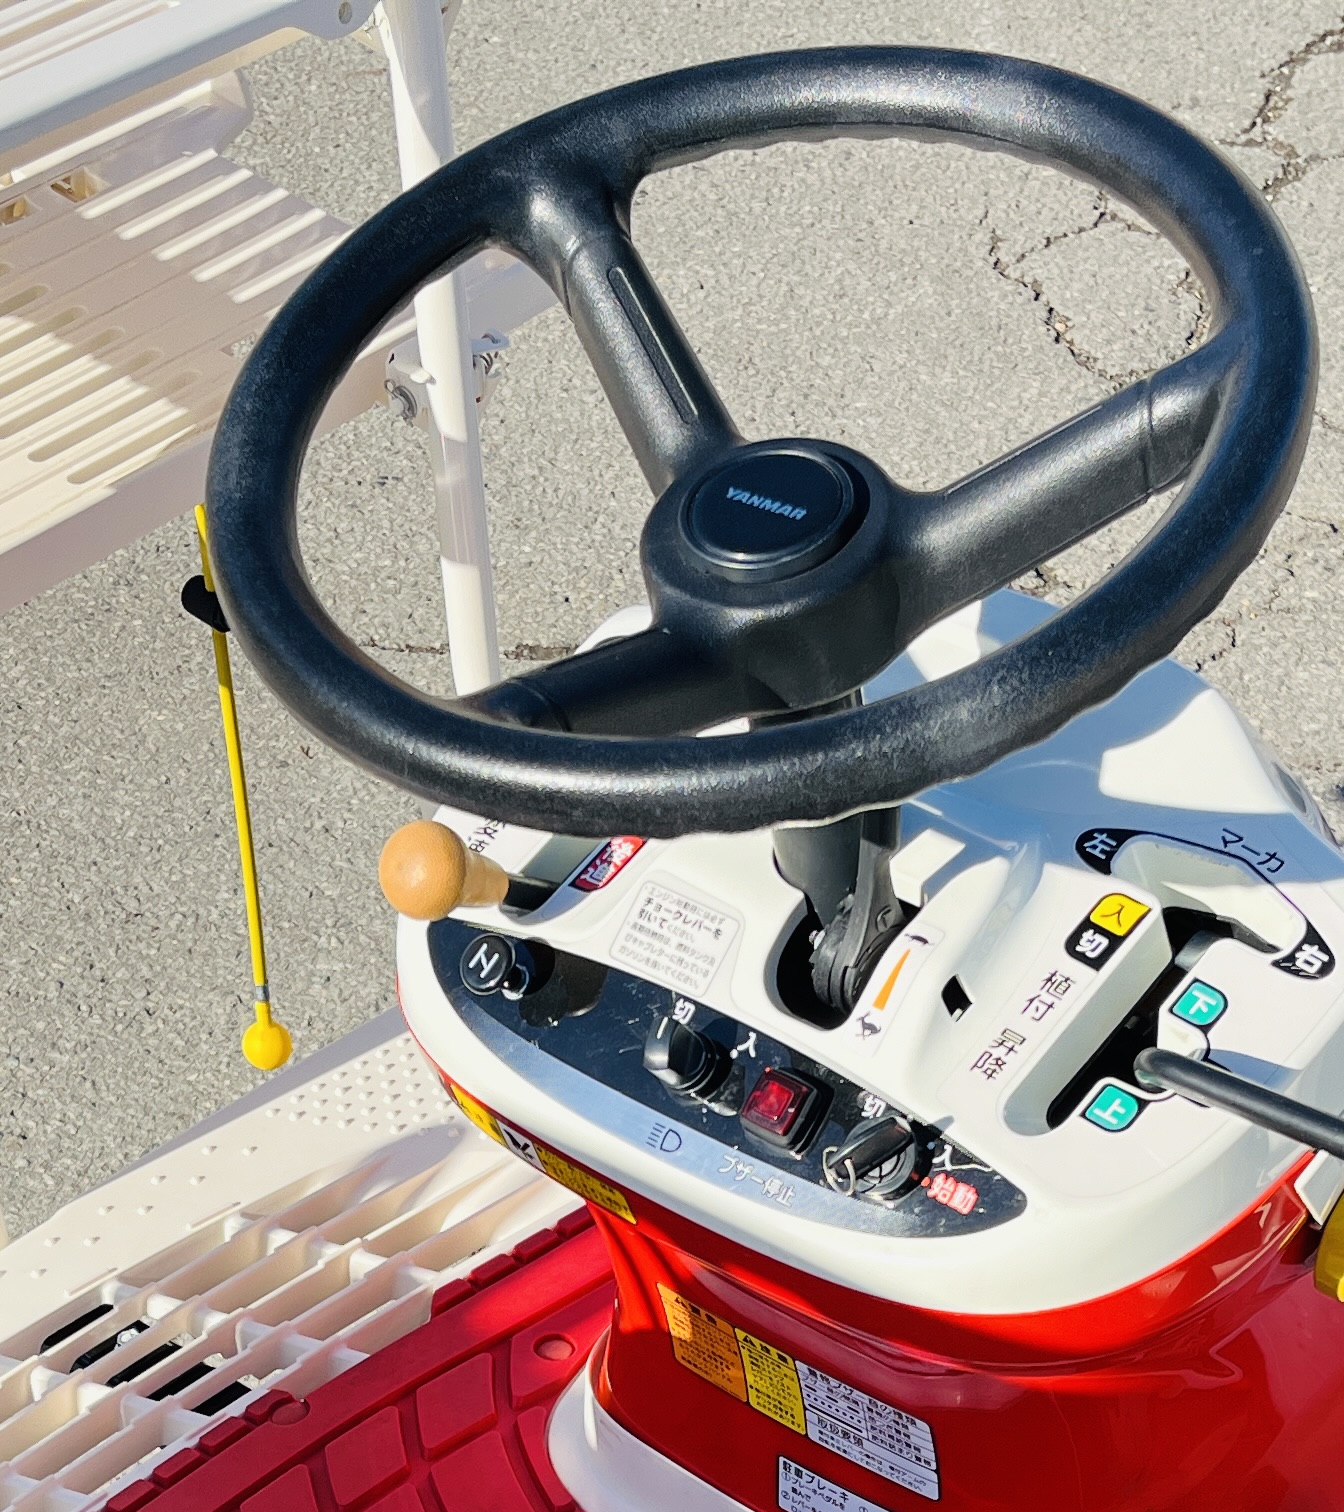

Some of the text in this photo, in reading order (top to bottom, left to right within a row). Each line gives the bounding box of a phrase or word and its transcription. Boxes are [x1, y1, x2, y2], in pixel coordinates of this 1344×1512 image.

[725, 486, 808, 521] YANMAR
[1082, 831, 1117, 860] 左
[1220, 827, 1285, 874] マーカ
[1100, 903, 1125, 928] 入
[1075, 929, 1109, 959] 切
[1294, 943, 1330, 973] 右
[672, 998, 696, 1025] 切
[1188, 988, 1218, 1016] 下
[969, 970, 1076, 1081] 植付 昇降
[862, 1094, 886, 1119] 切
[1093, 1097, 1127, 1125] 上
[927, 1170, 979, 1216] 始動
